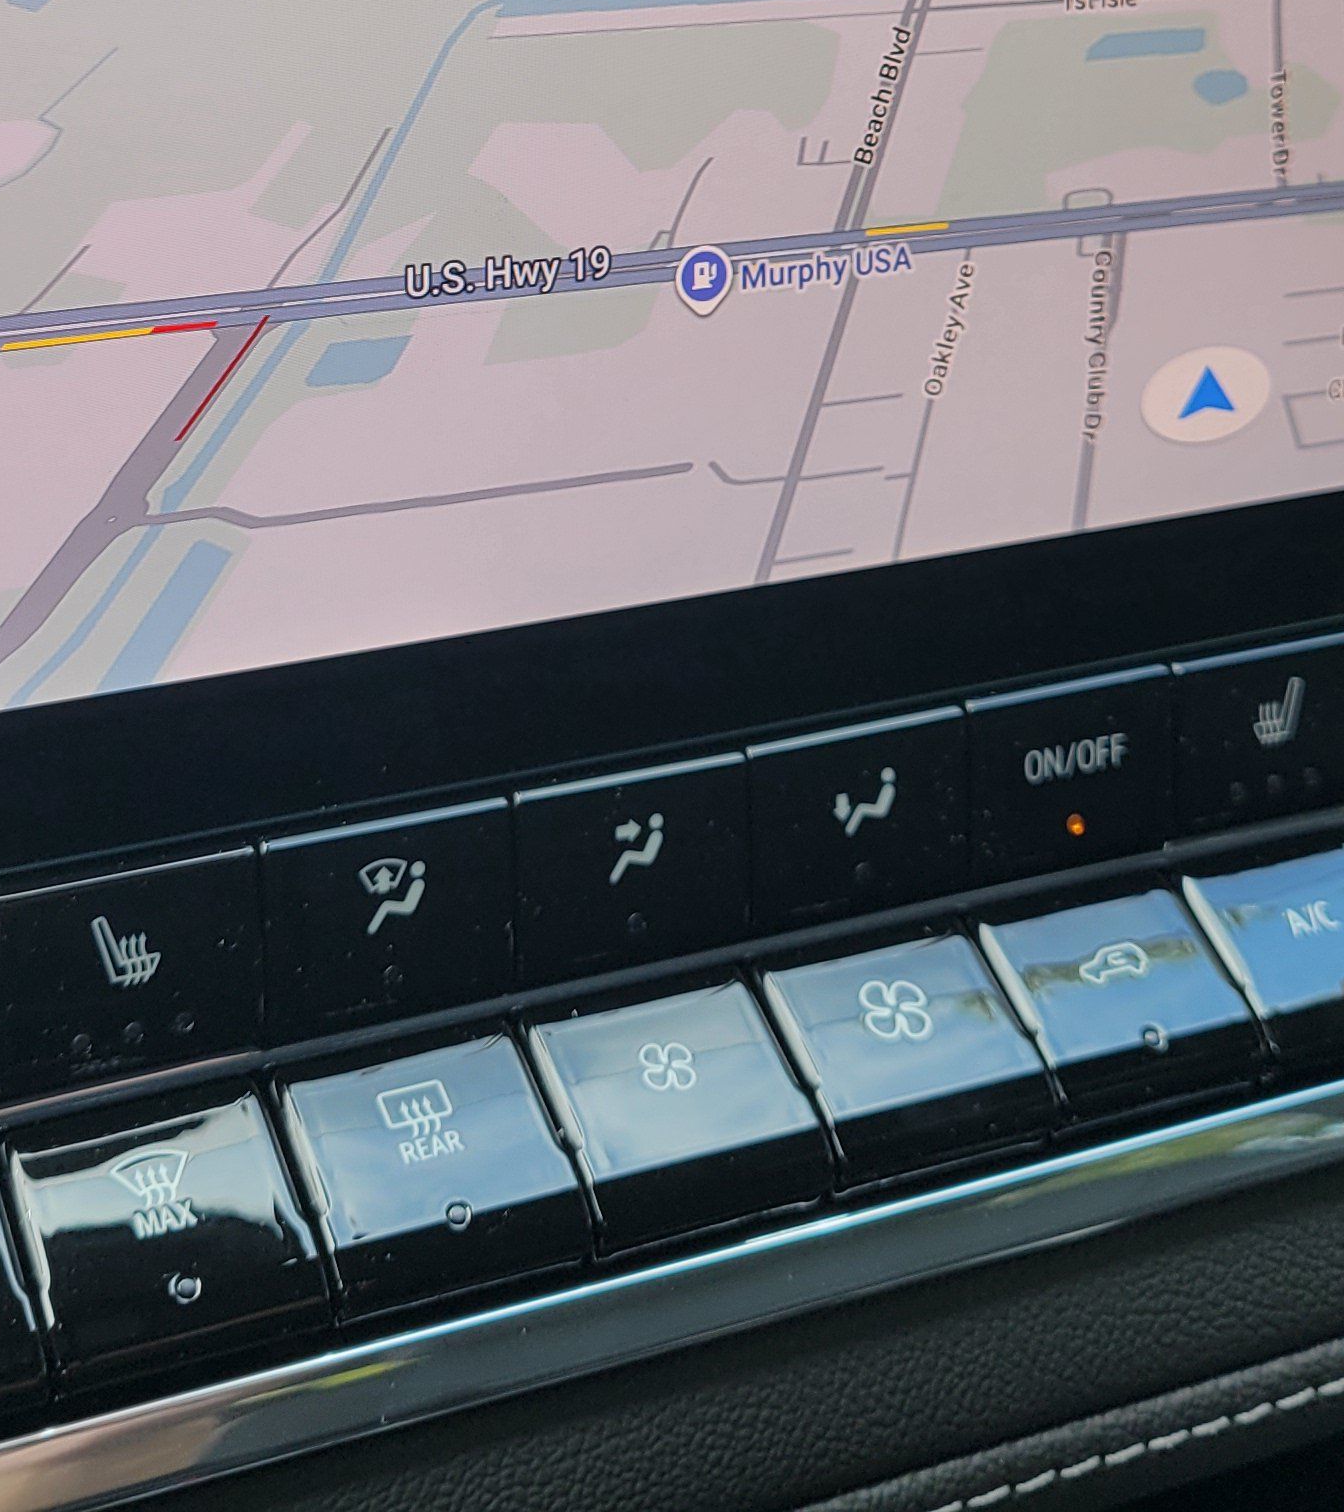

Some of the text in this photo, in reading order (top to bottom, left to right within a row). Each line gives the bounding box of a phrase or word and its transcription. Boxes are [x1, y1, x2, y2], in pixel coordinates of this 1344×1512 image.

[854, 26, 912, 165] Beach Blvd
[1270, 70, 1289, 177] Tower Dr
[404, 245, 612, 299] U.S. Hwy 19
[741, 248, 913, 290] Murphy USA
[924, 262, 974, 397] Oakley Ave
[1084, 250, 1113, 441] Country Club Dr
[1023, 734, 1129, 785] ON/OFF
[1288, 900, 1338, 938] A/C
[400, 1128, 467, 1165] REAR
[133, 1200, 199, 1239] MAX
